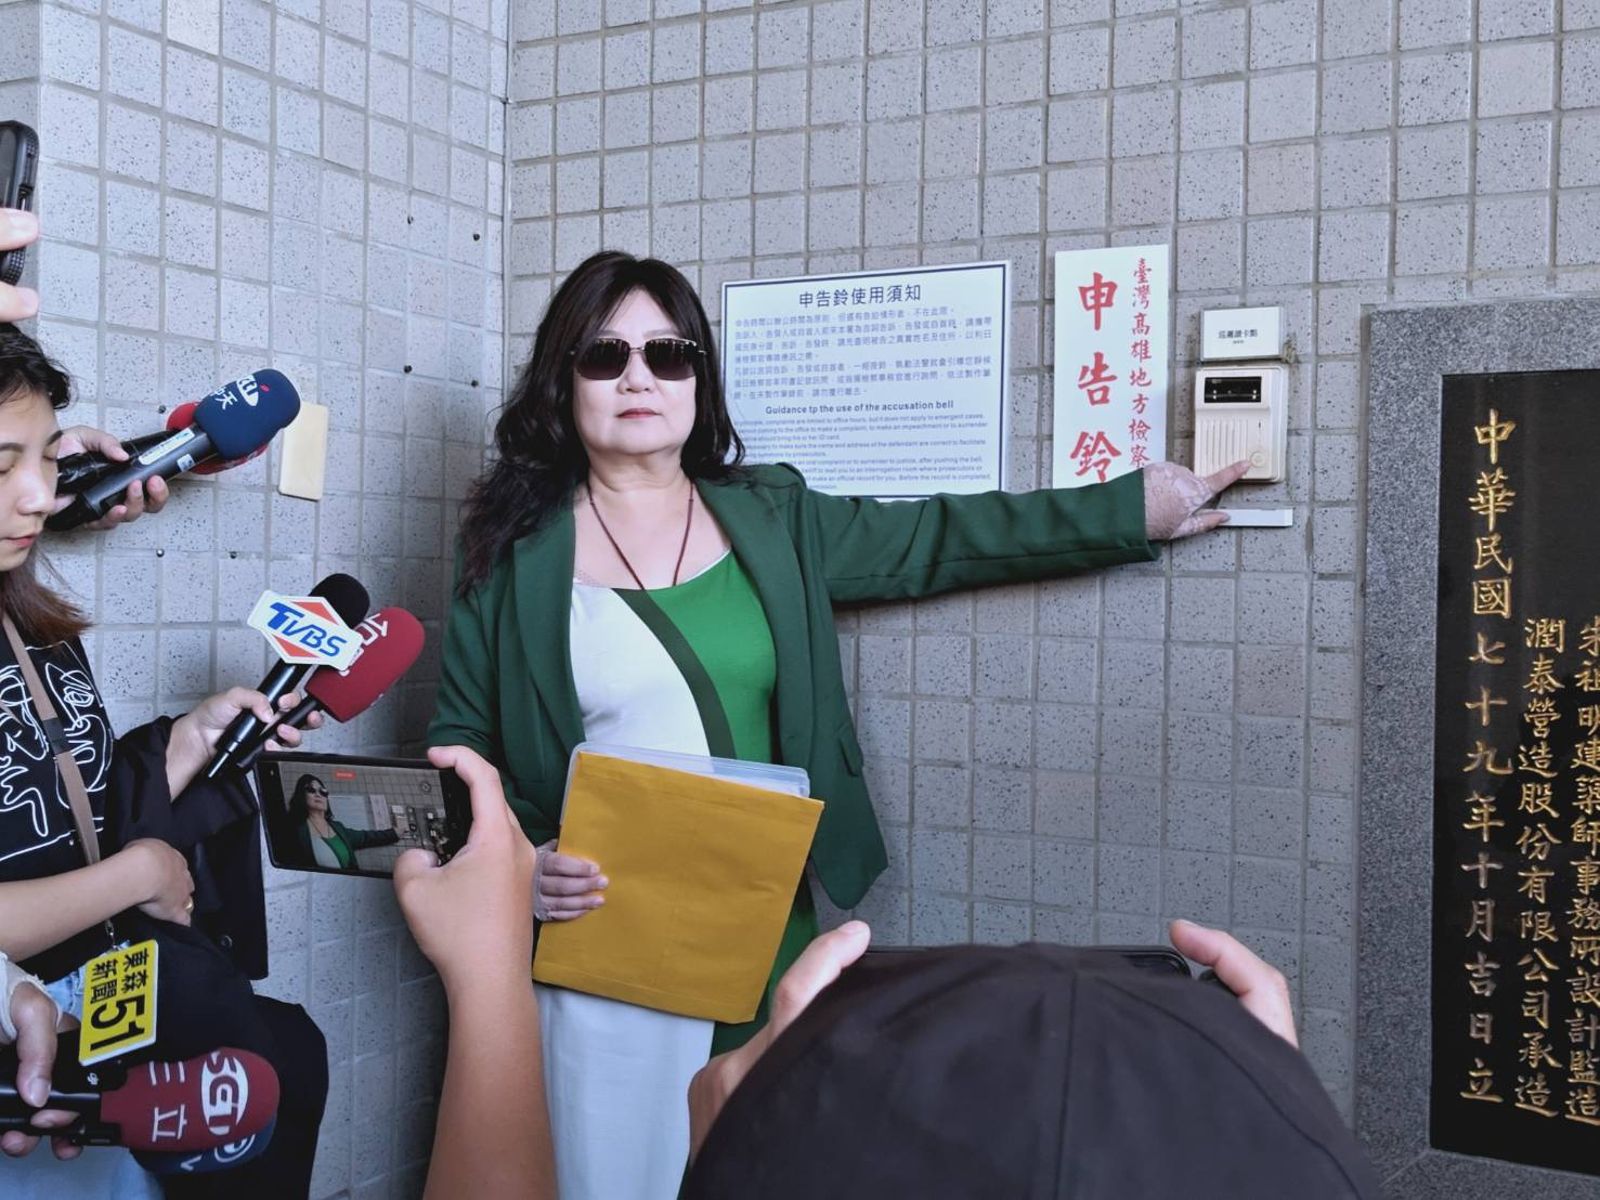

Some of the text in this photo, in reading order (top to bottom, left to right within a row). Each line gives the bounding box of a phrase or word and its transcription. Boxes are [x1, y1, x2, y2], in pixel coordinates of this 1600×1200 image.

[799, 284, 922, 308] 申告鈴使用須知
[1070, 271, 1122, 484] 申告鈴
[765, 405, 806, 416] Guidance
[820, 405, 834, 413] the
[855, 403, 864, 412] of
[865, 402, 879, 411] the
[881, 401, 934, 411] accusation
[936, 400, 954, 409] bell
[267, 602, 348, 657] TVBS
[1460, 408, 1516, 1103] 中華民國七十九年十月吉日立
[1514, 618, 1566, 1117] 潤泰營造股份有限公司承造
[90, 958, 118, 1005] 新聞
[122, 947, 149, 994] 東森
[89, 994, 146, 1052] 51
[149, 1061, 188, 1142] 三立
